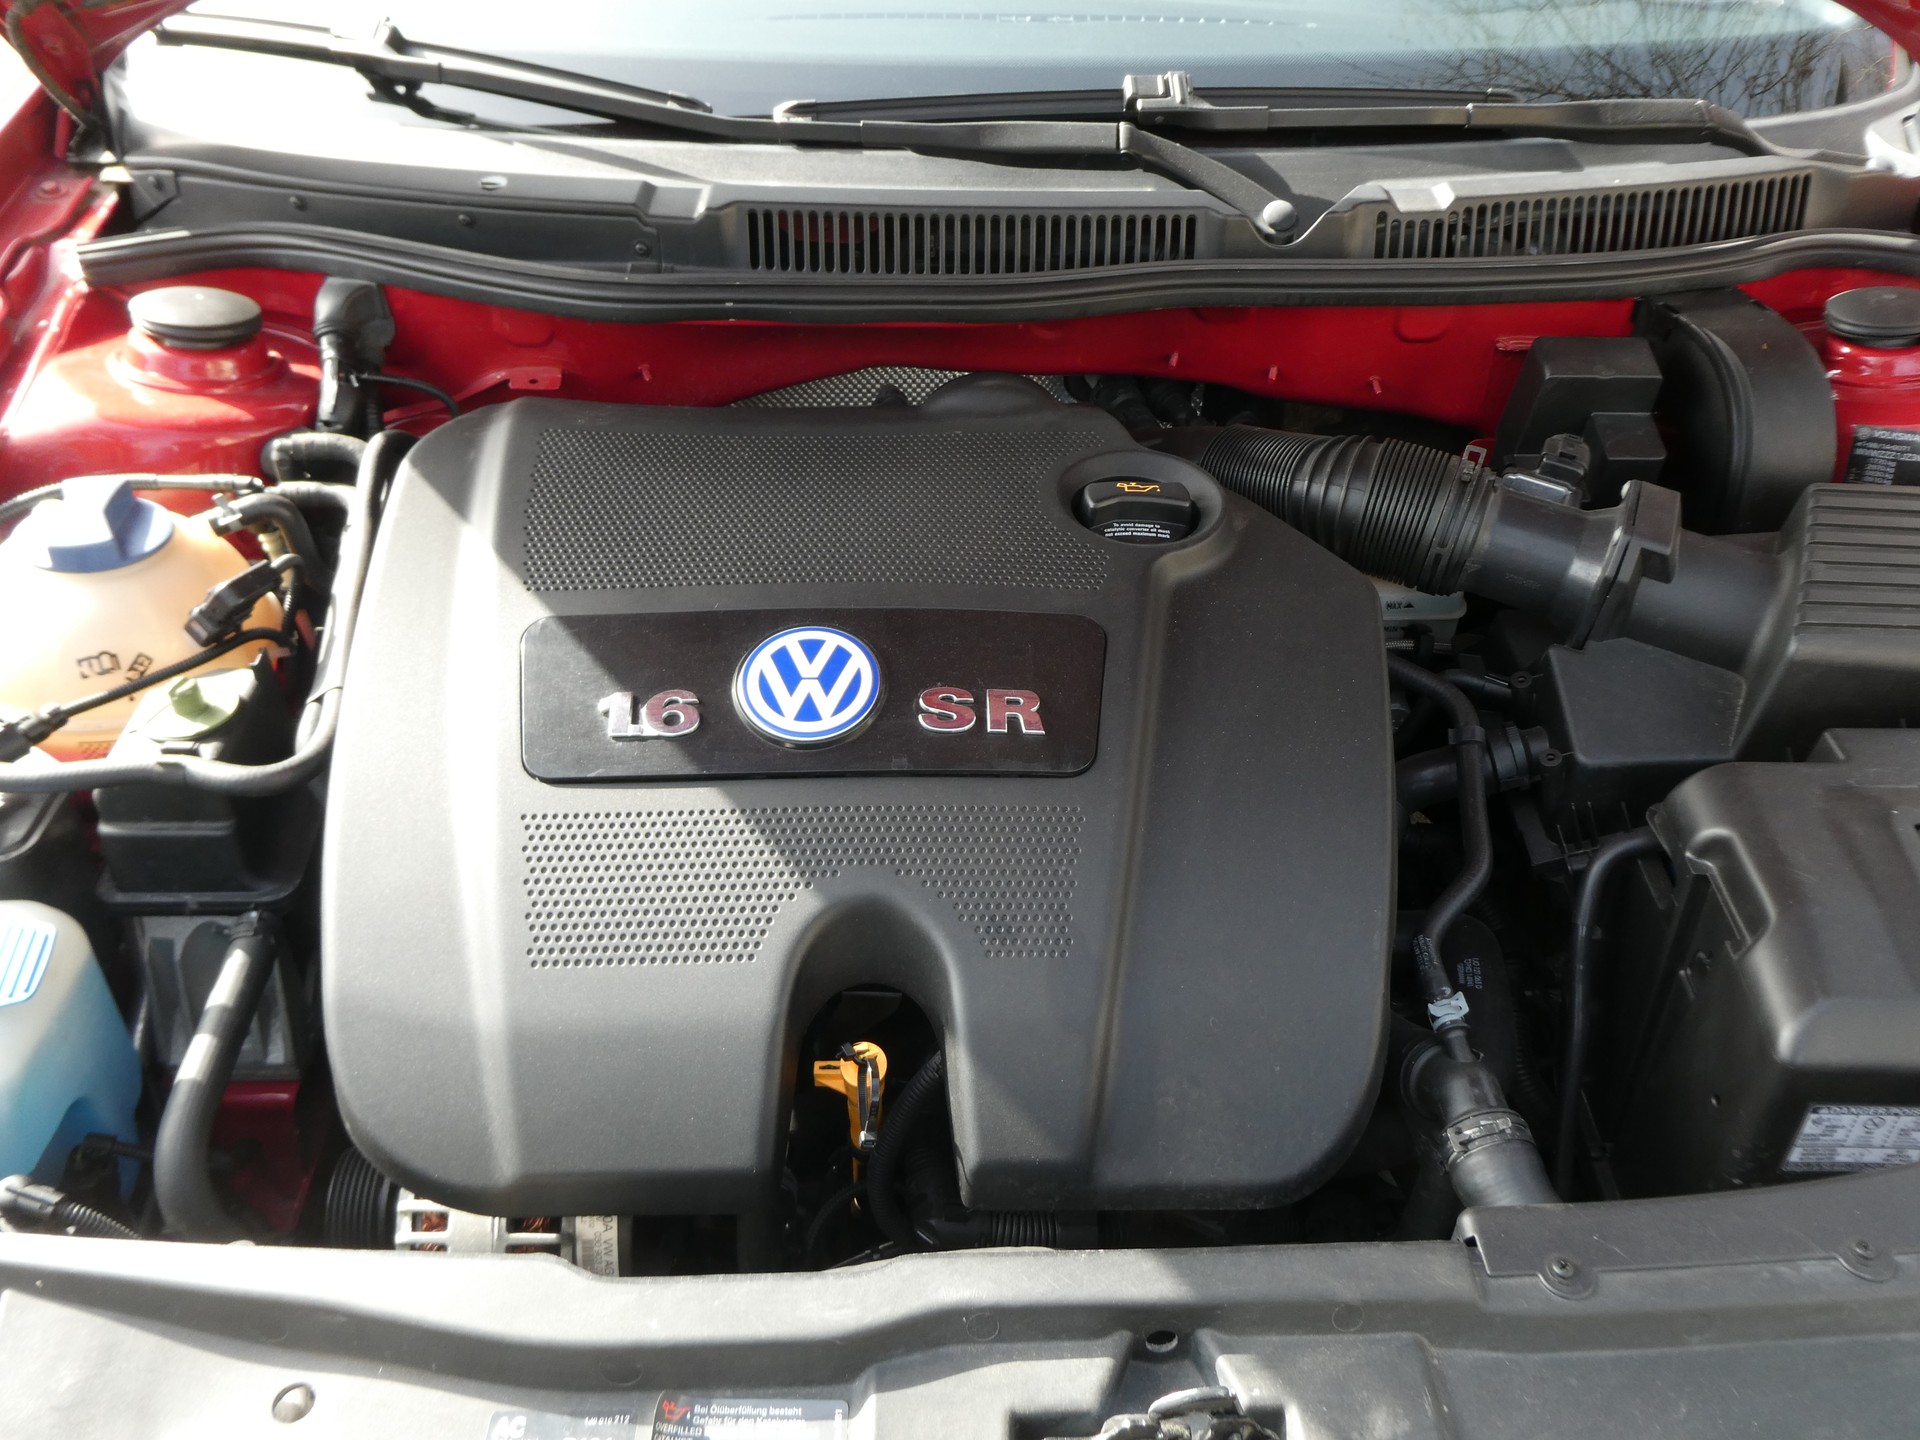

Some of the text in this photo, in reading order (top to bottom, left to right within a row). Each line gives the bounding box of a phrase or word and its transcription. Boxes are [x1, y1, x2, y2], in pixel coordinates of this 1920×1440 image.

[1386, 601, 1402, 610] MAX
[598, 689, 700, 741] 1.6
[918, 686, 1046, 736] SR
[694, 1403, 802, 1416] Bei Ölüberfüllung besteht
[724, 1416, 736, 1426] für
[655, 1421, 702, 1437] OVERFILLED
